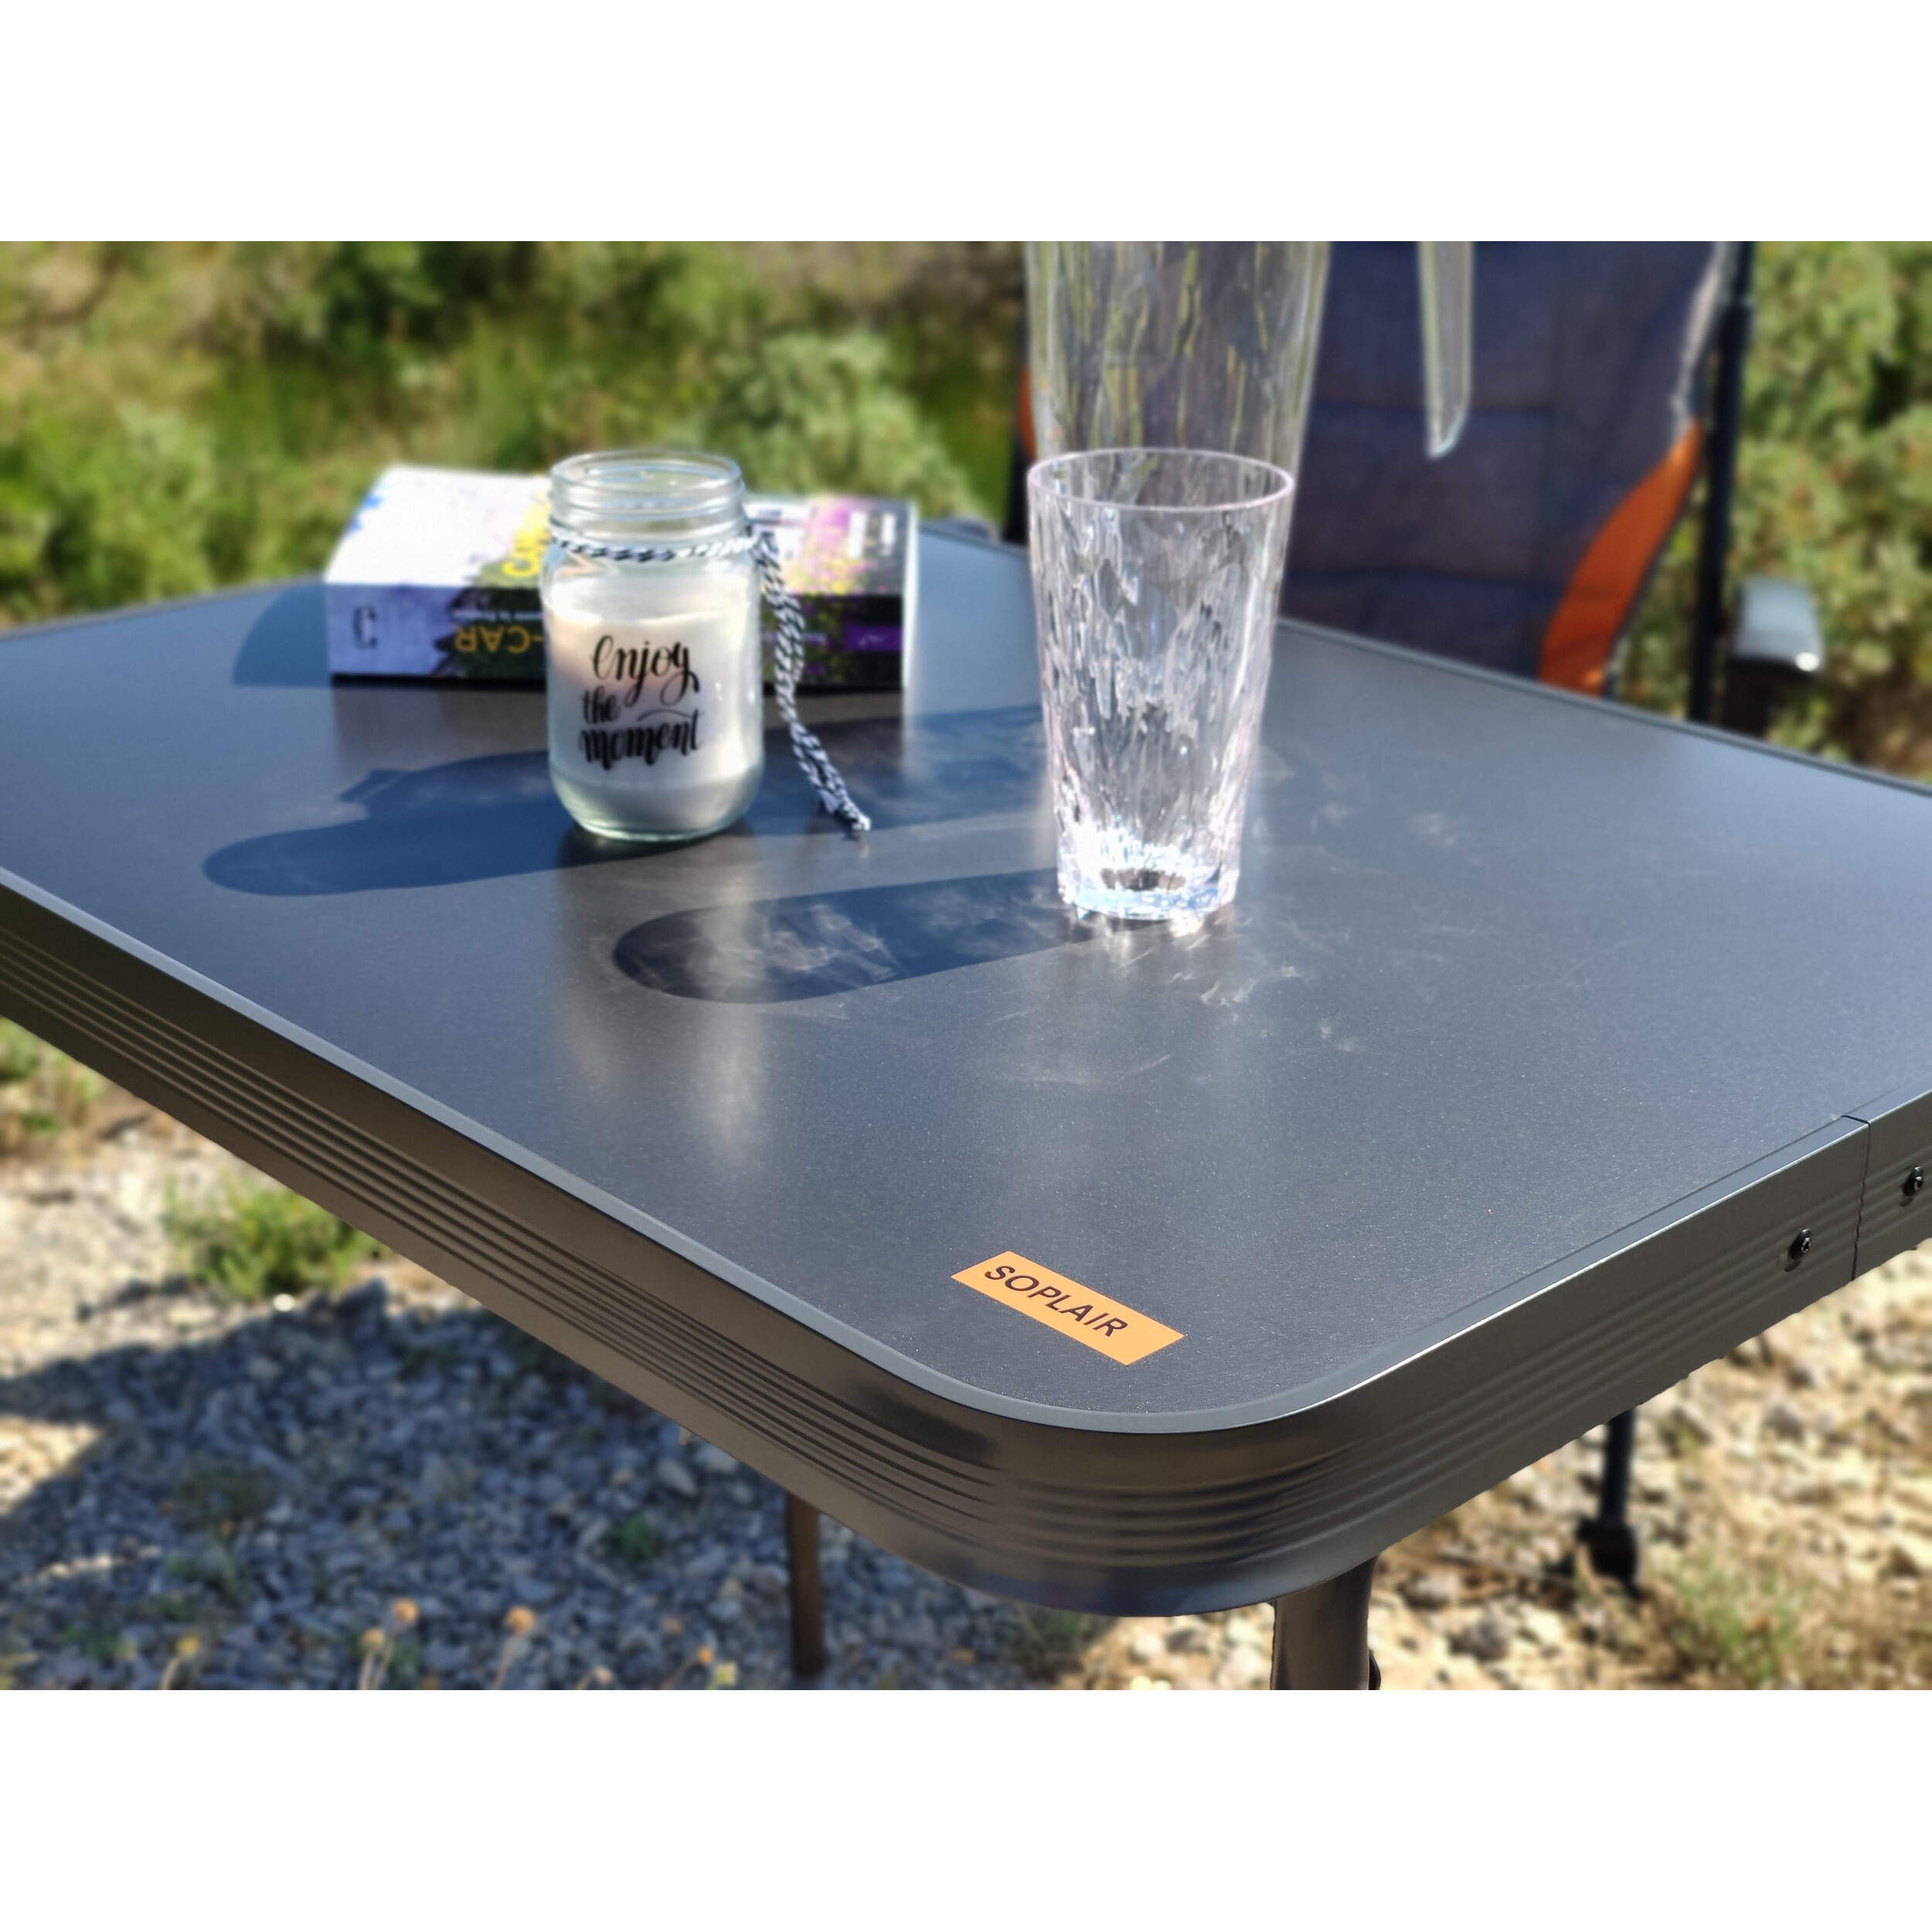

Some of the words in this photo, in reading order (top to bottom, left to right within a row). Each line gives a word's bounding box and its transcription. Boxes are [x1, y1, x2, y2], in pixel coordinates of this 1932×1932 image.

[582, 685, 621, 724] the
[580, 708, 702, 771] moment
[984, 1265, 1128, 1337] SOPLAIR
